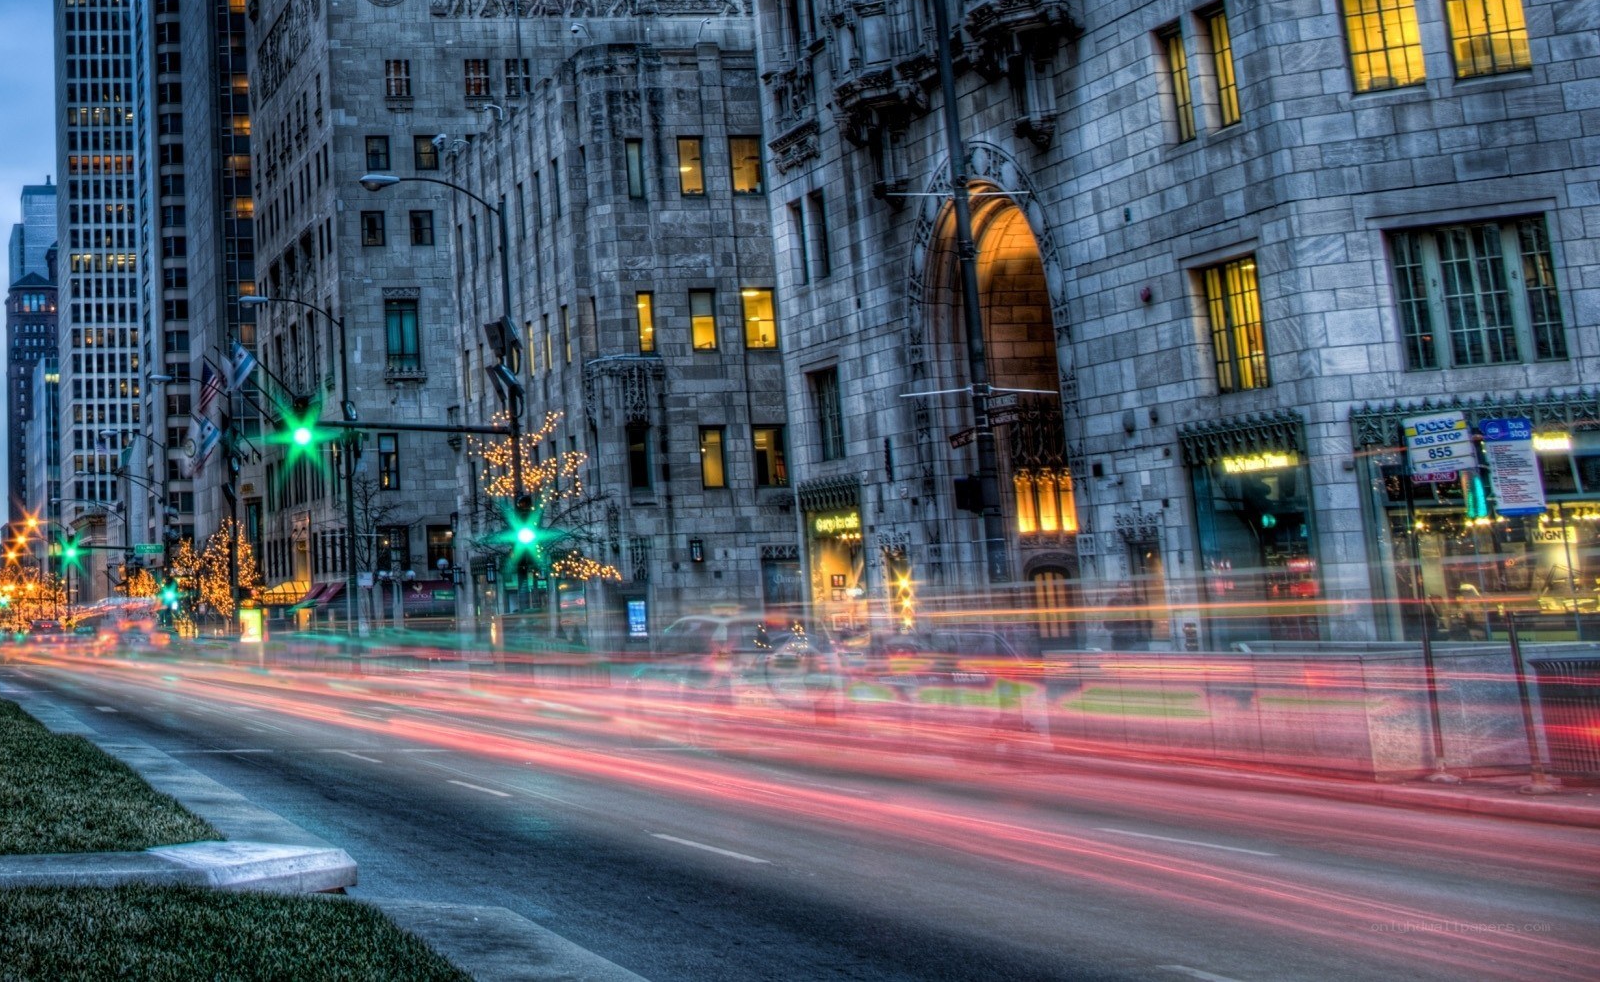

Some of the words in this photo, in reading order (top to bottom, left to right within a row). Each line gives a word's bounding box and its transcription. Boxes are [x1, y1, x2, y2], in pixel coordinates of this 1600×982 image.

[1415, 419, 1454, 435] pace
[1507, 420, 1524, 429] bus
[1415, 436, 1434, 445] BUS
[1437, 432, 1461, 442] STOP
[1510, 429, 1529, 438] stop
[1428, 446, 1453, 459] 855
[1433, 471, 1451, 480] ZONE
